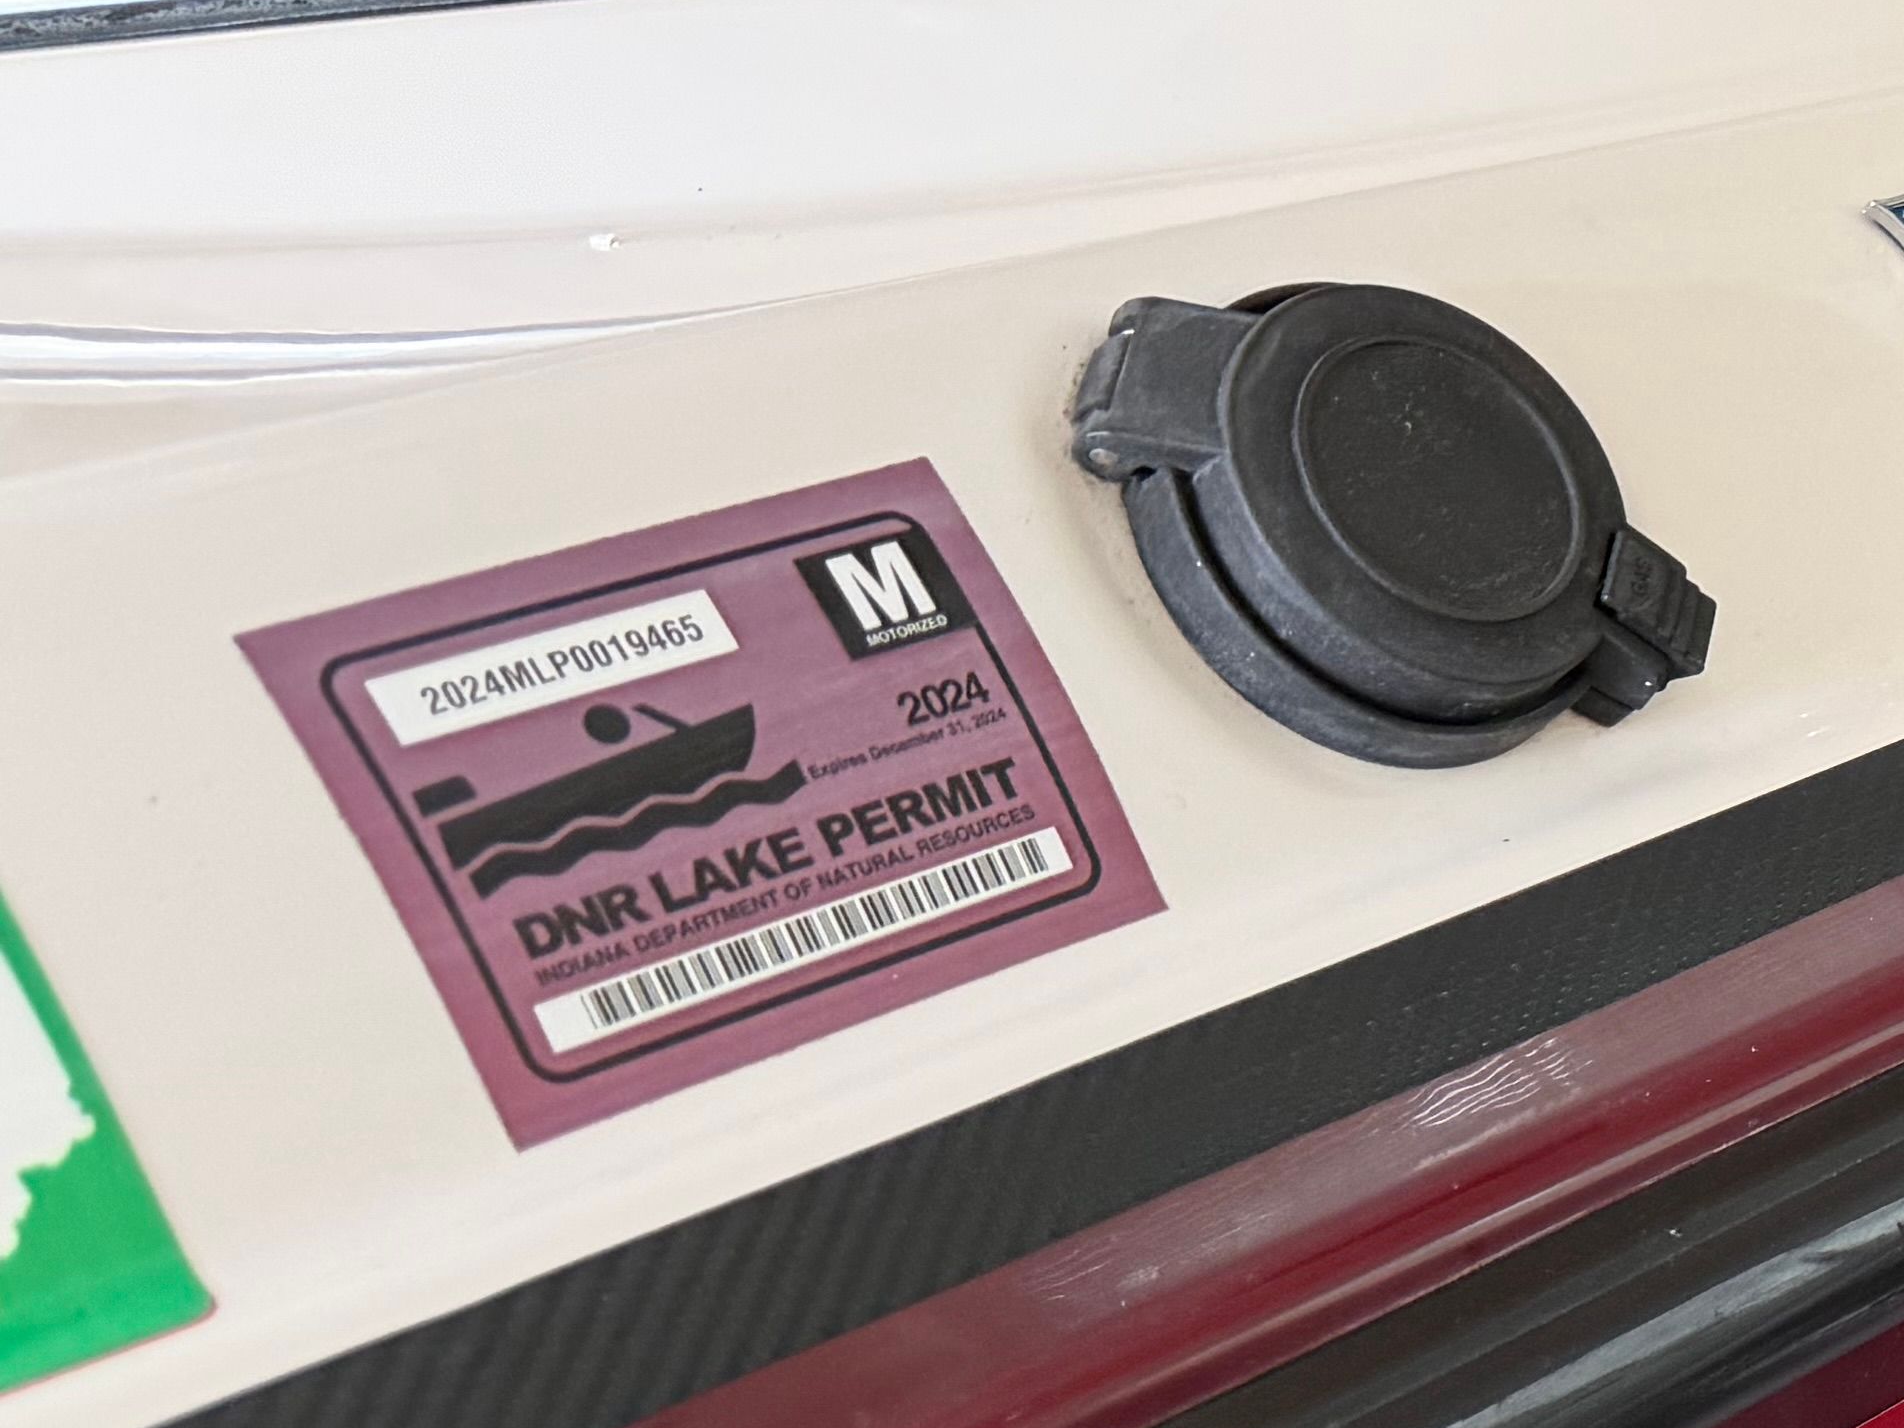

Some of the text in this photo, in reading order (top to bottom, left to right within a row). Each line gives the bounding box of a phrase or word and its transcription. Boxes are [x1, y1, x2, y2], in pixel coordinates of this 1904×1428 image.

[825, 540, 937, 632] M
[866, 614, 948, 647] MOTORIZED
[420, 613, 704, 716] 2024MLP0019465
[897, 671, 990, 727] 2024
[807, 707, 1007, 780] Expires December 31, 2024
[511, 755, 1018, 961] DNR LAKE PERMIT
[534, 803, 1036, 987] INDIANA DEPARTMENT OF NATURAL RESOURCES
